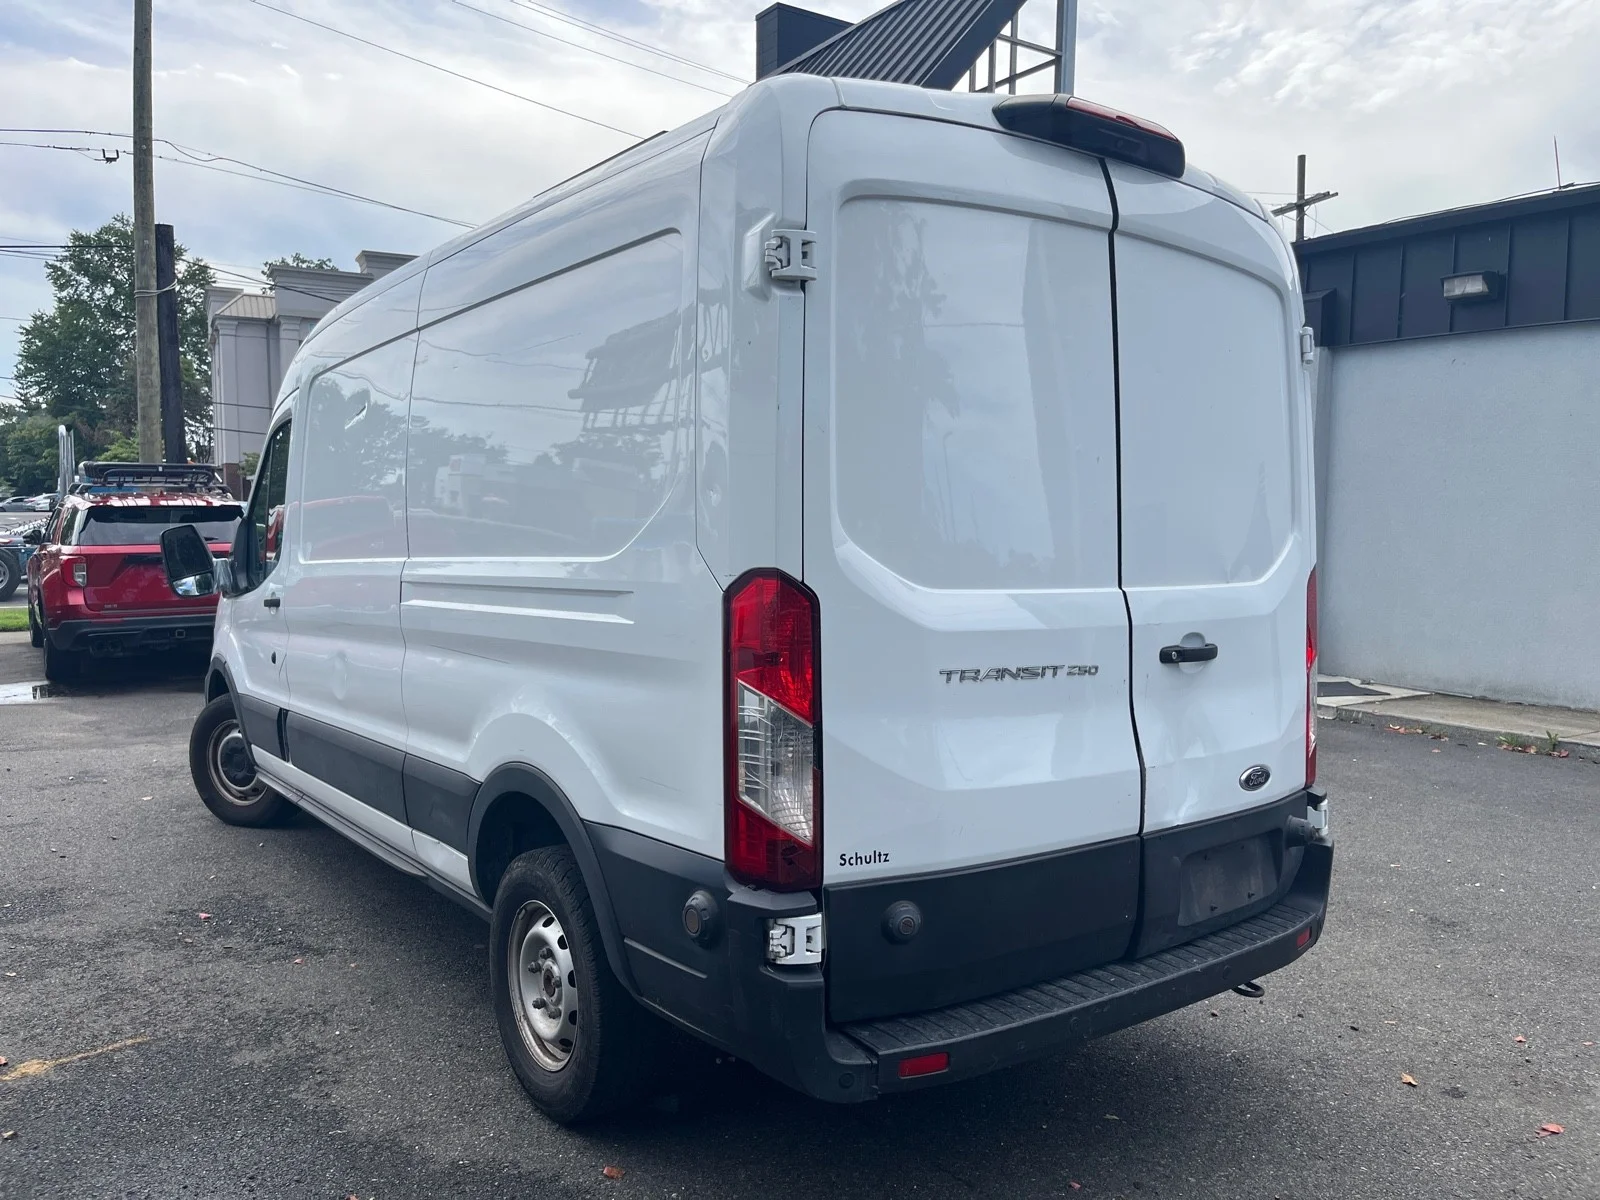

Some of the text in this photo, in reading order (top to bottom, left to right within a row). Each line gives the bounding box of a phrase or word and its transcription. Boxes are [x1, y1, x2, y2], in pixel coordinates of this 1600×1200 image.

[939, 664, 1099, 684] TRANSIT 250
[839, 850, 890, 867] Schultz
